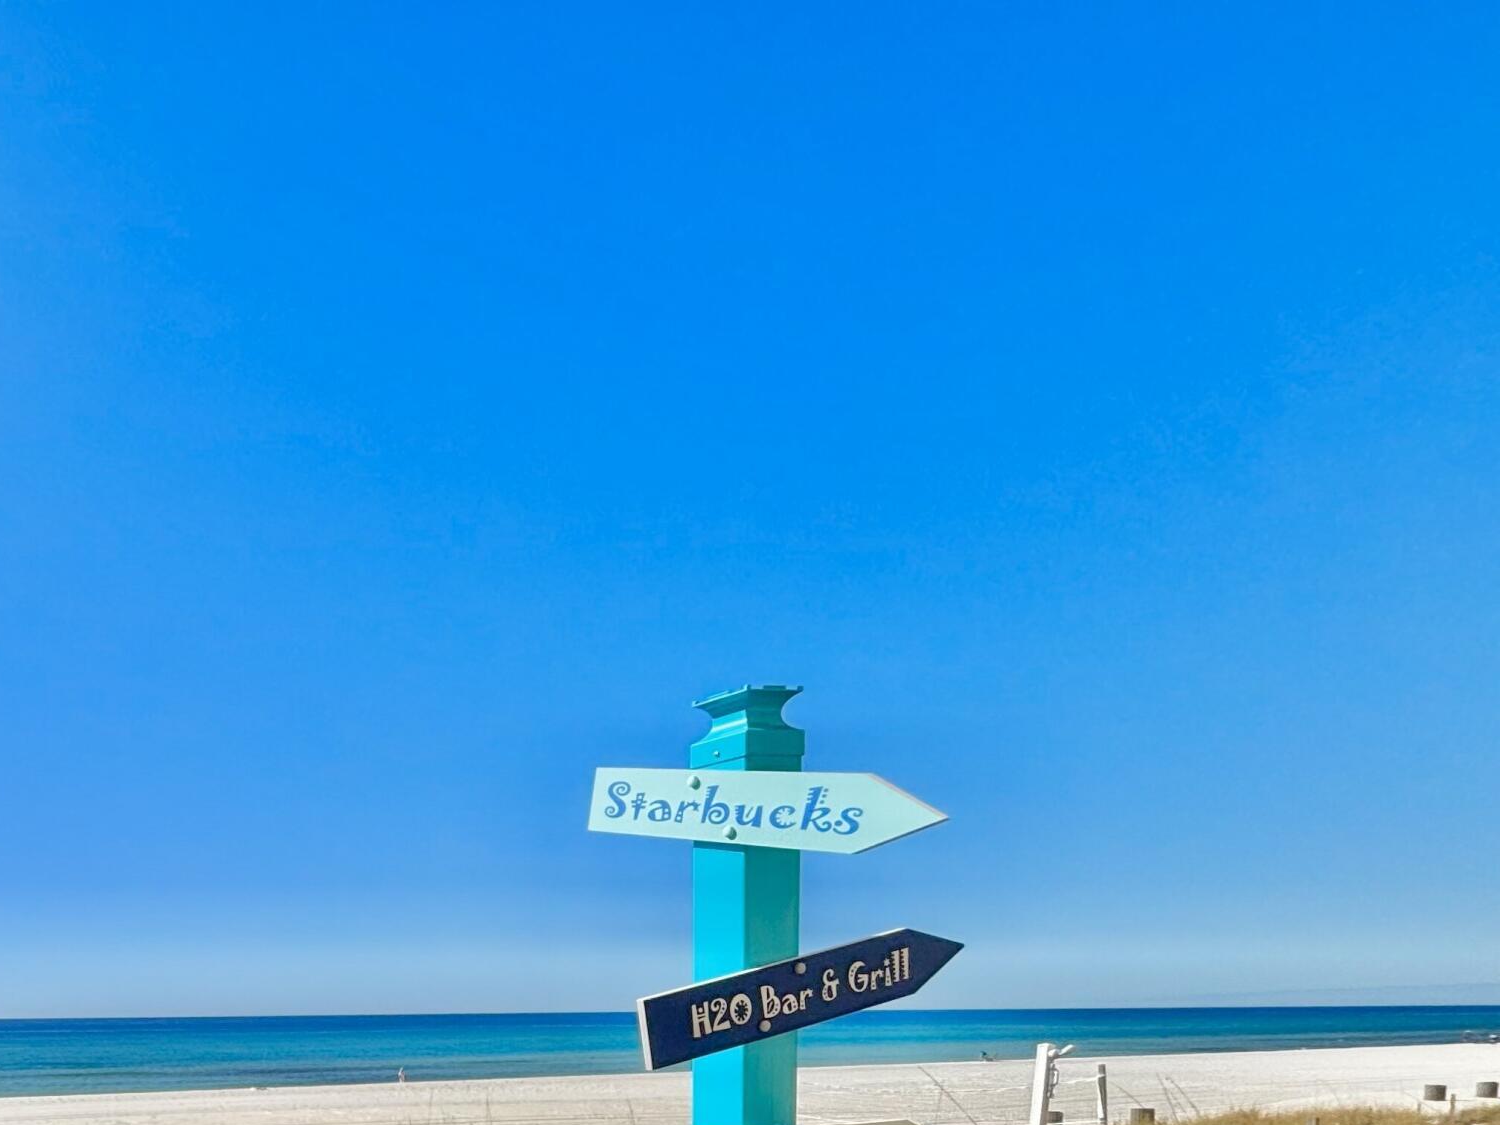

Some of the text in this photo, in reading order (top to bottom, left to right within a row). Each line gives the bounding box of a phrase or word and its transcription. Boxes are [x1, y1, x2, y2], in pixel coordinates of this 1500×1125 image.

[604, 780, 864, 836] Starbucks
[759, 984, 813, 1020] Bar
[821, 968, 840, 1002] &
[848, 946, 911, 993] Grill
